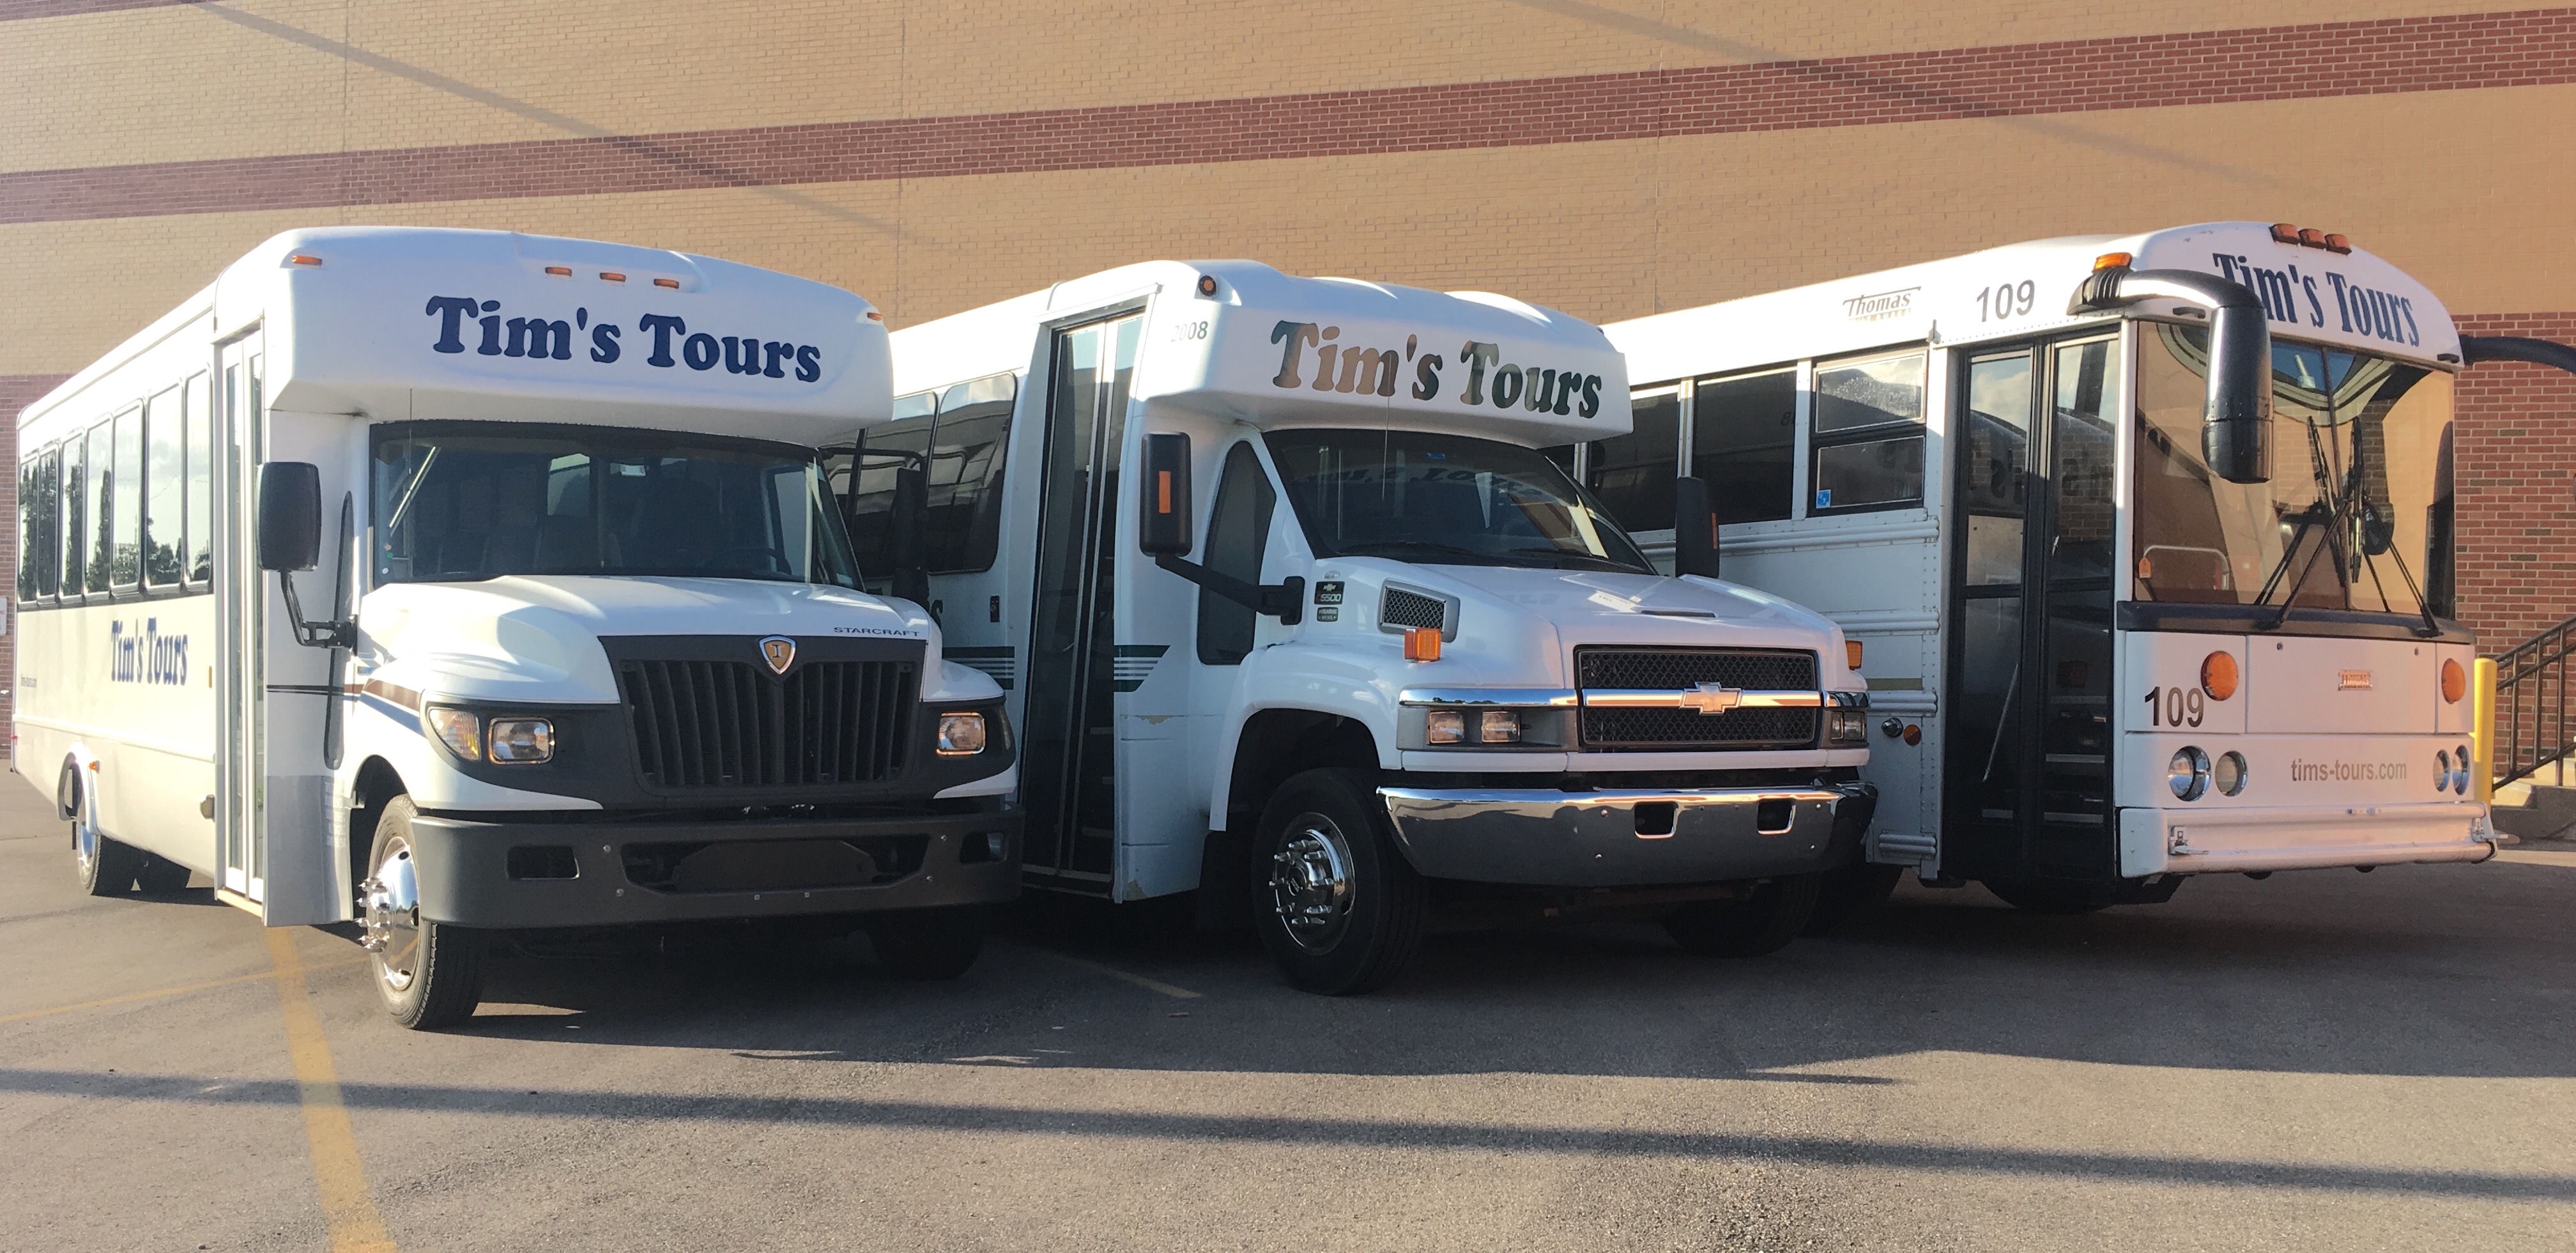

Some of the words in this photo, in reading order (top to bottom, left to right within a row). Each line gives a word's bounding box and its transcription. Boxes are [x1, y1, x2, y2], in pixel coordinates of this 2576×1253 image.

[1843, 286, 1922, 316] Thomas
[1977, 279, 2035, 323] 109
[2326, 272, 2419, 347] Tours
[426, 295, 621, 364] Tim's
[640, 313, 822, 383] Tours
[1170, 321, 1208, 342] 2008
[1271, 320, 1443, 401] Tim's
[1460, 340, 1602, 419] Tours
[111, 618, 143, 684] Tim's
[146, 617, 188, 686] Tours
[834, 627, 920, 636] STARCRAFT
[2145, 686, 2204, 727] 109
[2291, 758, 2407, 781] tims-tours.com
